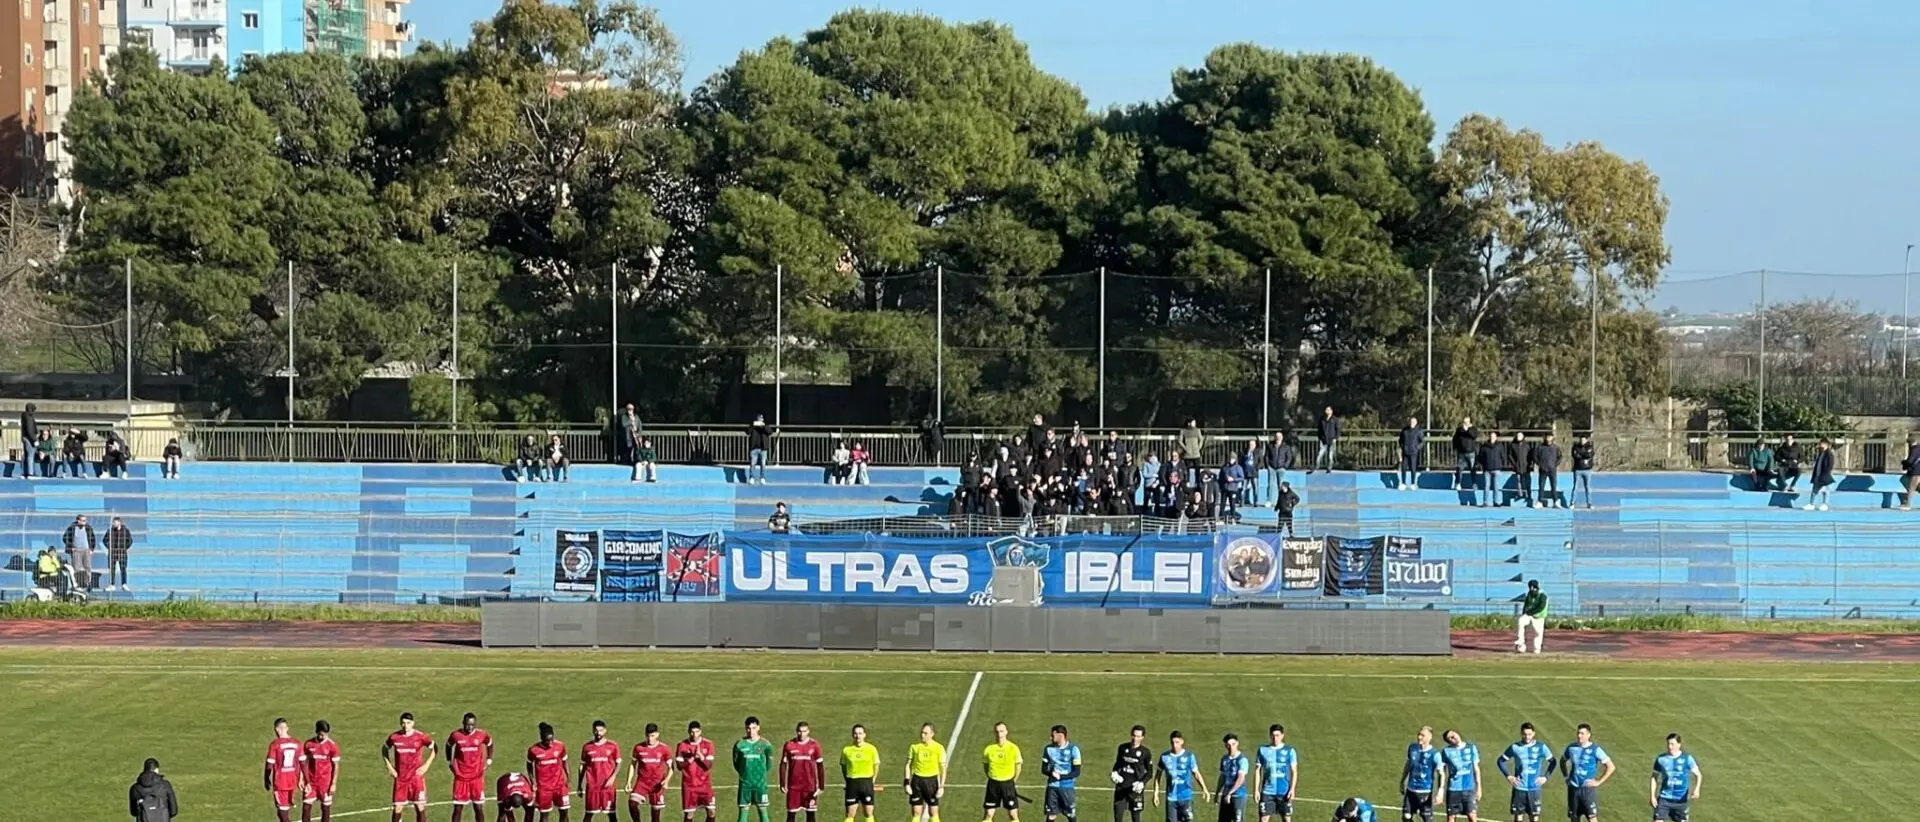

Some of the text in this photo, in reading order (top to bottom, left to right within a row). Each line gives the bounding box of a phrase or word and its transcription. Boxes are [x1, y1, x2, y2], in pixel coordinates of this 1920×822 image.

[732, 548, 1203, 594] ULTRAS IBLEI
[1388, 562, 1447, 584] 97100
